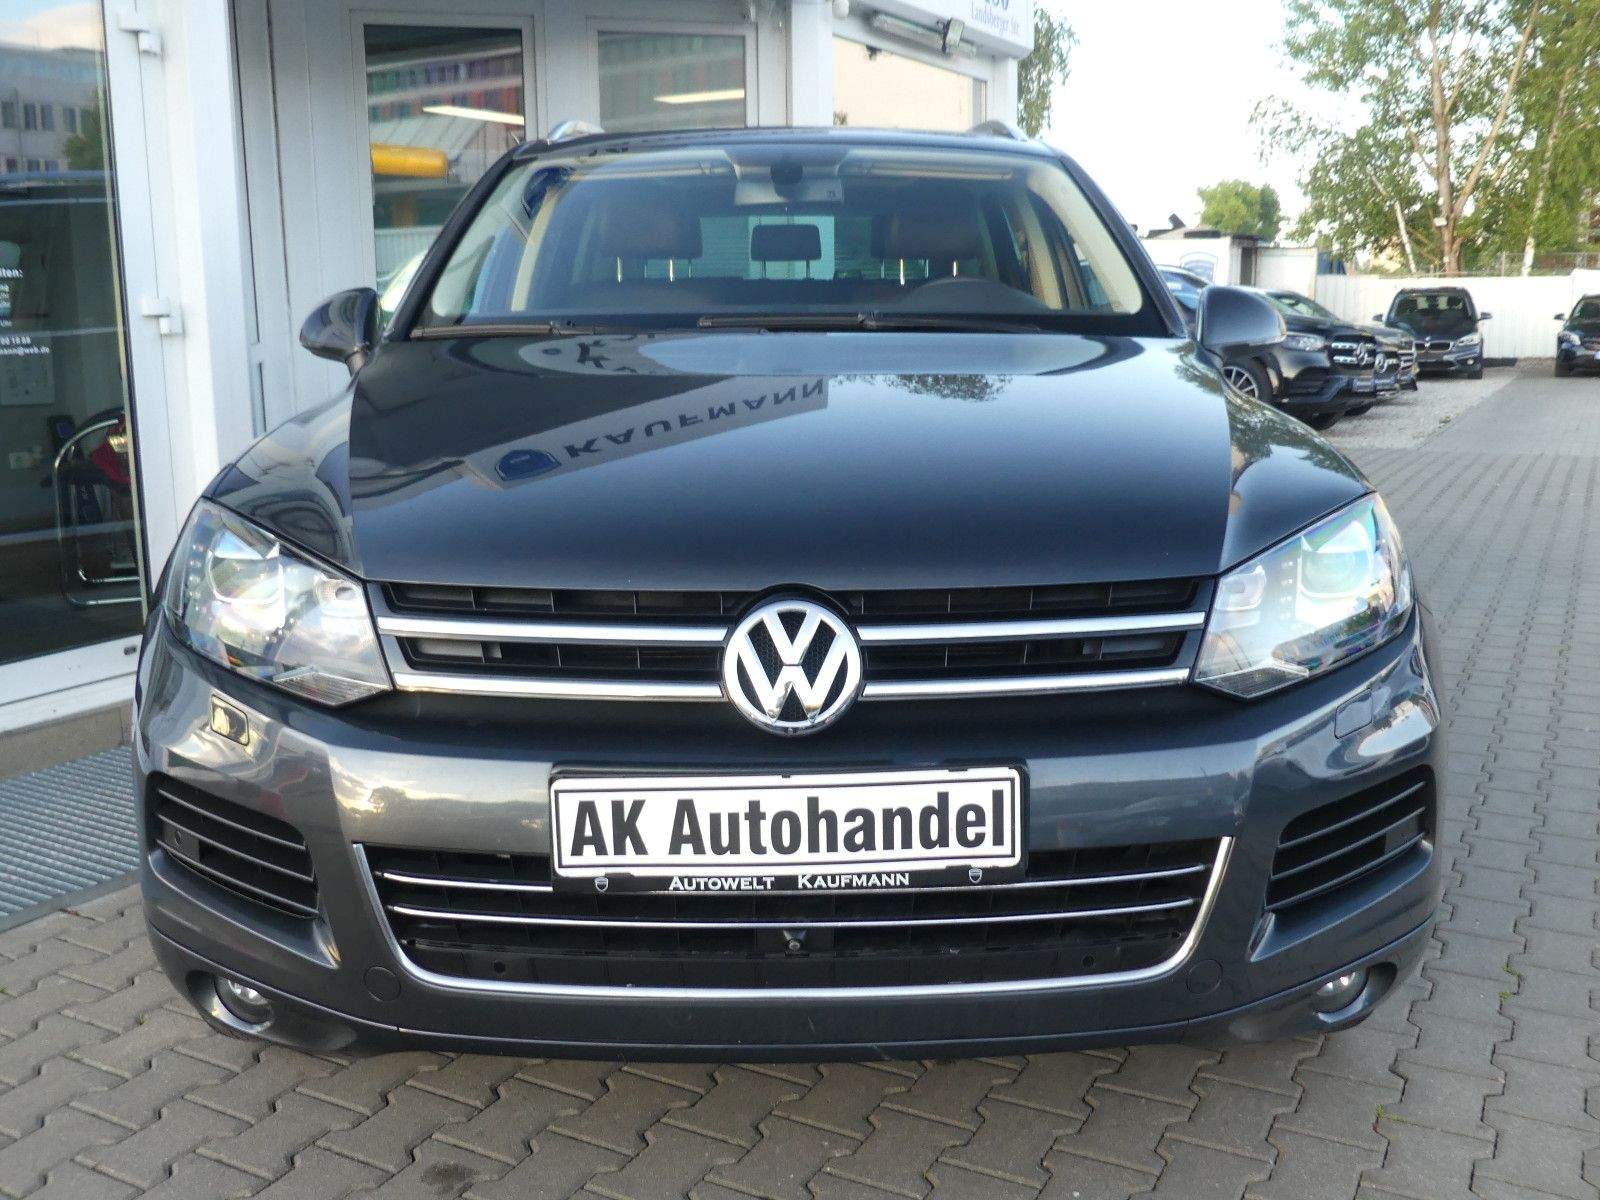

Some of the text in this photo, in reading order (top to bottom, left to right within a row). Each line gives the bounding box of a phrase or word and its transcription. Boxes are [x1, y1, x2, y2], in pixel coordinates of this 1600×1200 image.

[570, 789, 1005, 857] AK Autohandel
[668, 872, 910, 891] AUTOWELT KAUFMANN
